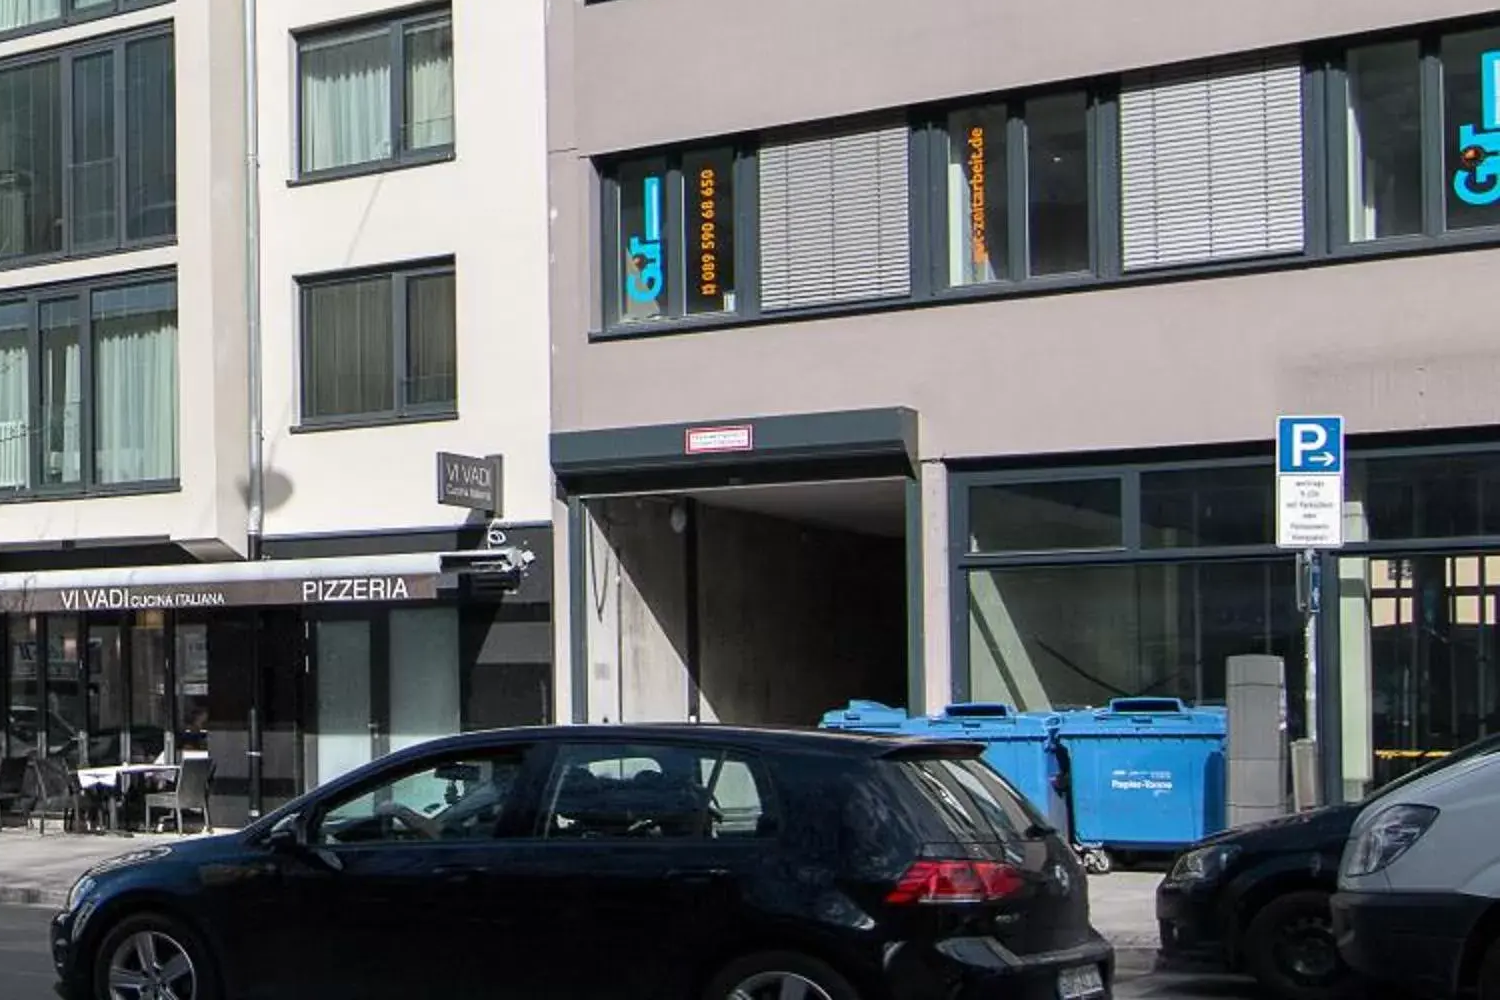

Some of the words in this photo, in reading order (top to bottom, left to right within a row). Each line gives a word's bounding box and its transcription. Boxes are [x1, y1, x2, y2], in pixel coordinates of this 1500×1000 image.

[701, 168, 714, 197] 650
[701, 199, 715, 220] 68
[701, 222, 715, 250] 590
[701, 253, 715, 281] 089
[1291, 423, 1328, 467] P
[61, 589, 79, 610] VI
[83, 587, 129, 609] VADI
[130, 595, 173, 609] CUCINA
[175, 592, 225, 607] ITALIANA
[302, 577, 409, 601] PIZZERIA
